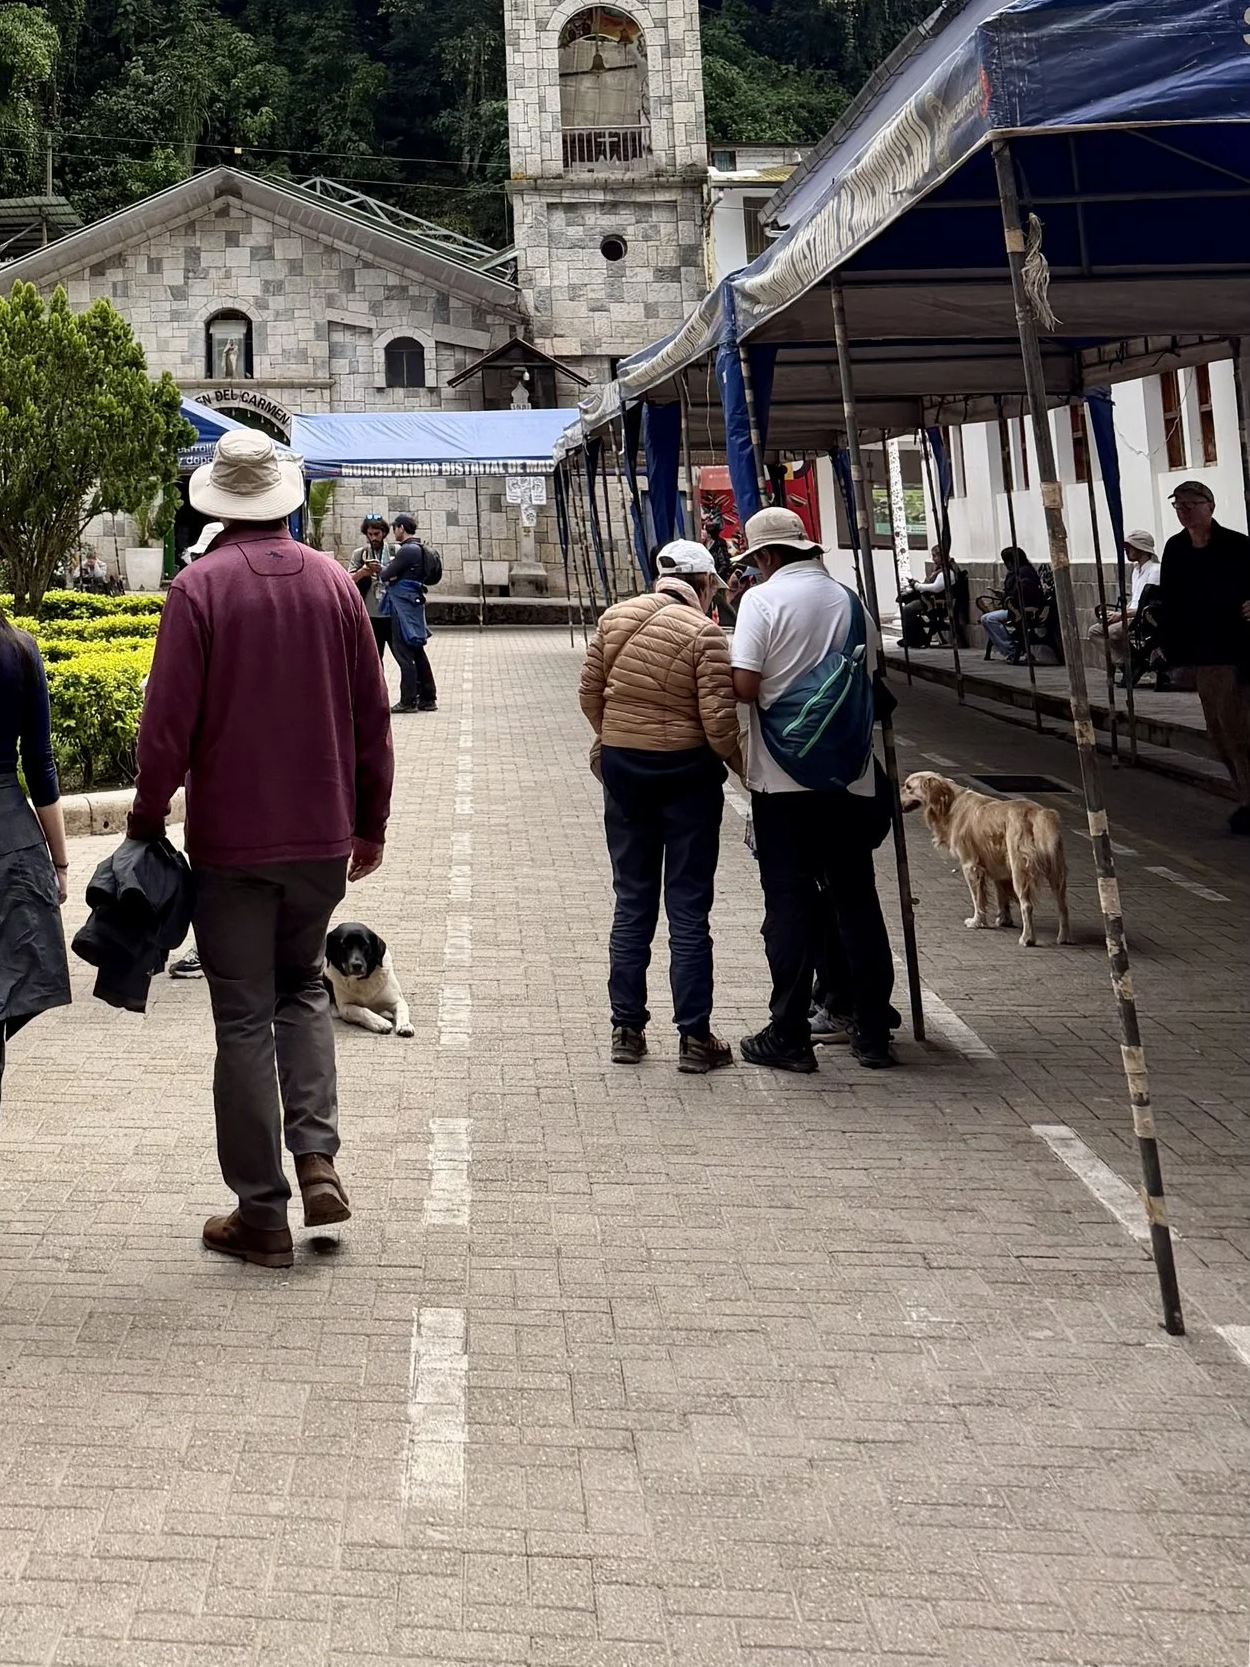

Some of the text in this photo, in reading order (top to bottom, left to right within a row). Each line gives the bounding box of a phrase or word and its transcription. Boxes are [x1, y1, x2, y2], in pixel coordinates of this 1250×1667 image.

[215, 389, 238, 402] DEL
[241, 392, 290, 425] CARMEN
[342, 463, 438, 476] MUNICIPALIDAD
[442, 460, 505, 476] DISTRITAL
[508, 460, 524, 473] DE
